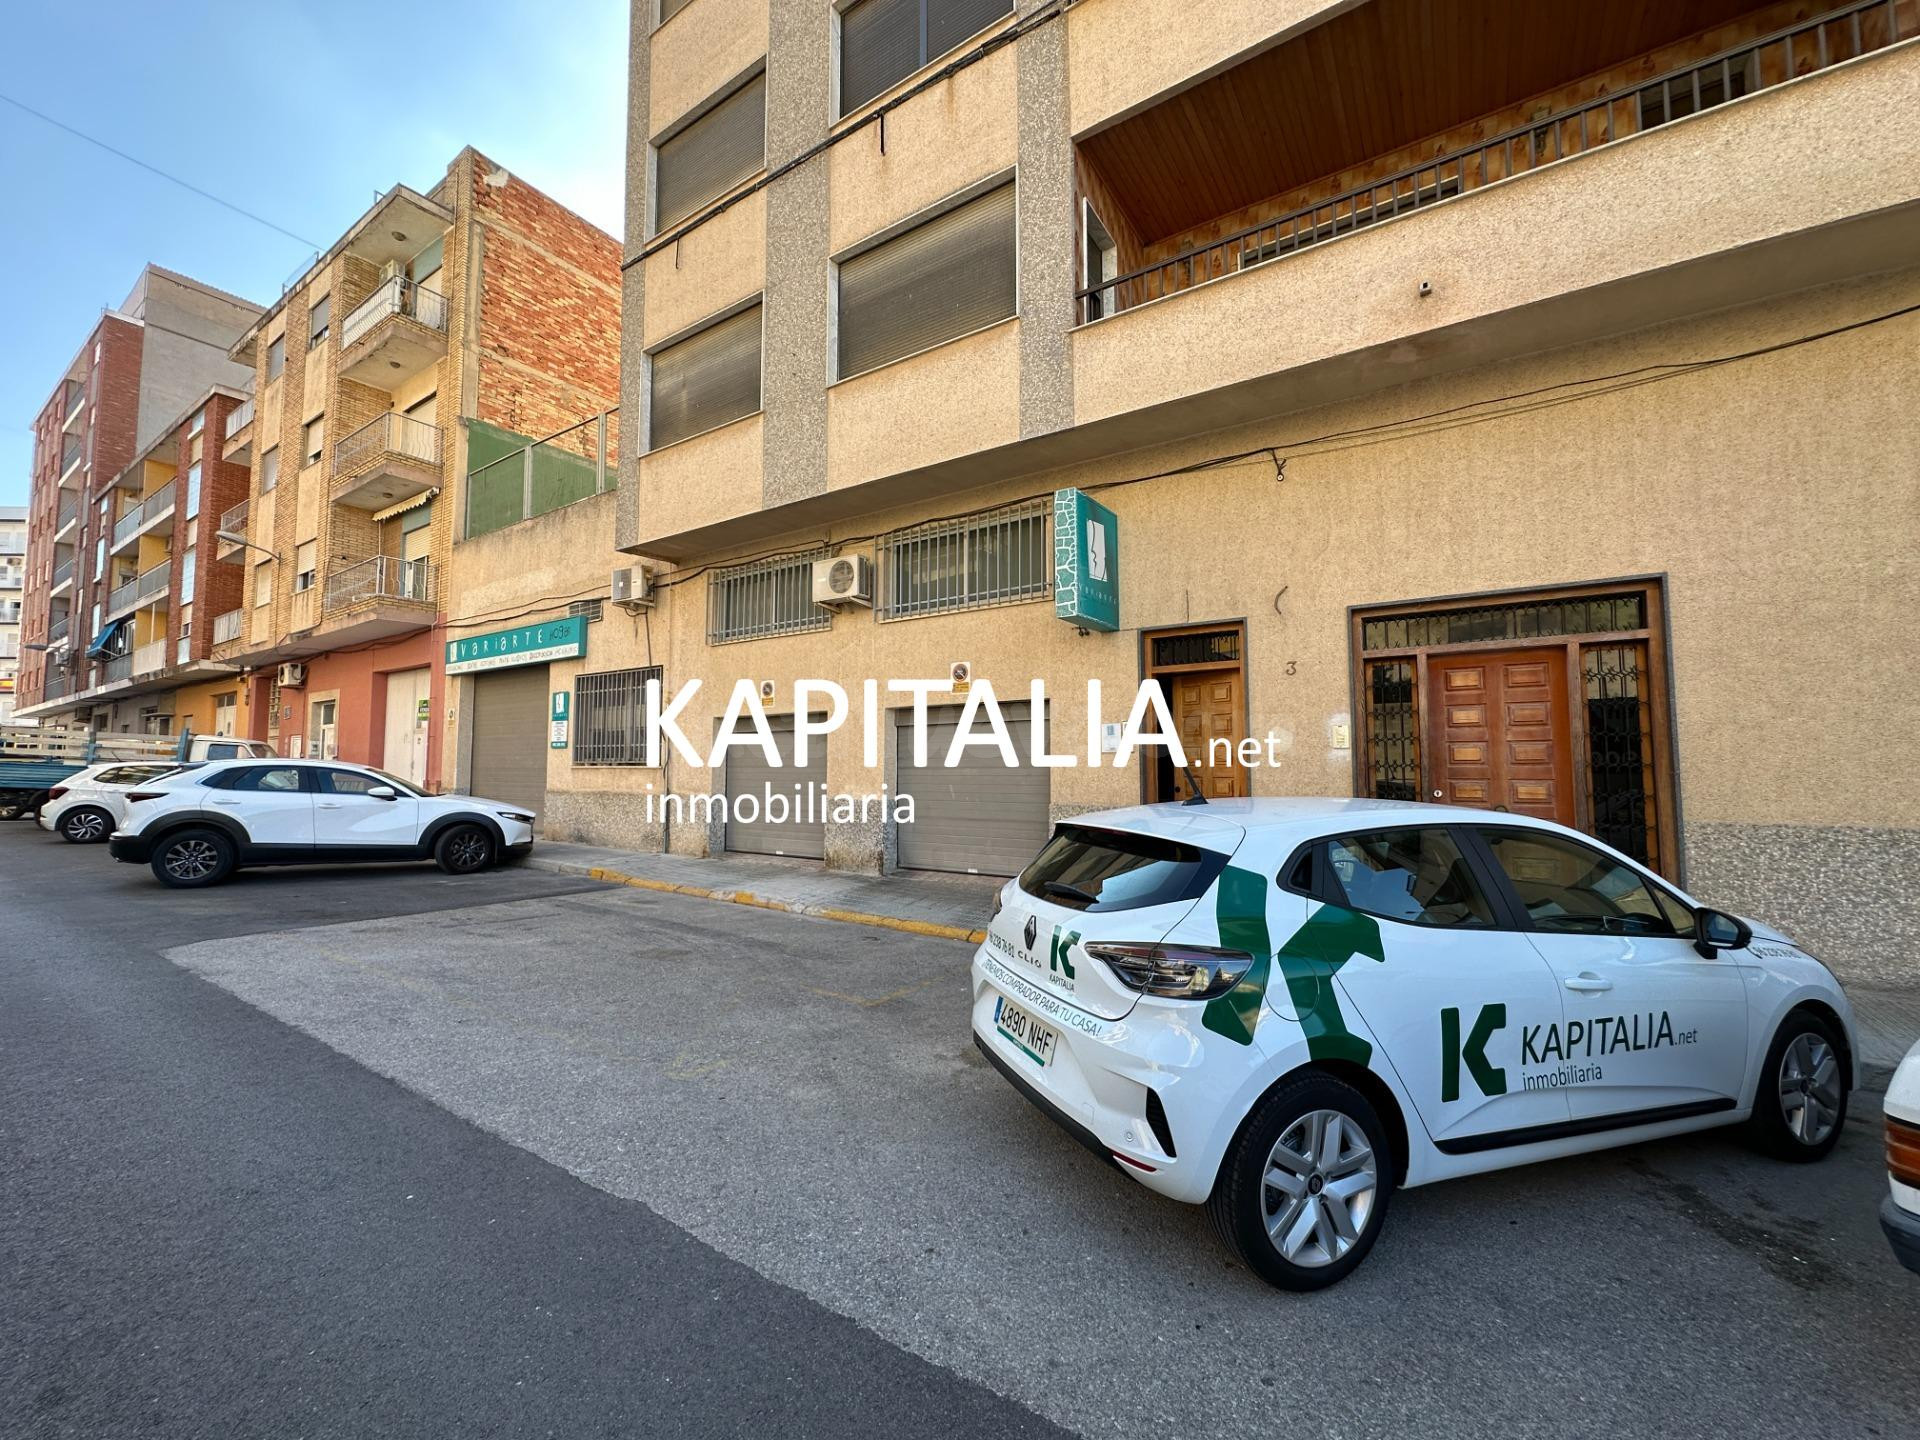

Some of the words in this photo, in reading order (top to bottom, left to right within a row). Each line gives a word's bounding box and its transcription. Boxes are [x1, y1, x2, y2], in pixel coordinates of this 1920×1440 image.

[1286, 660, 1297, 676] 3
[1017, 950, 1042, 968] CLIO
[1049, 973, 1075, 993] KAPITALIA
[1002, 973, 1042, 1005] COMPRADOR
[1039, 995, 1060, 1016] PARA
[1060, 1006, 1073, 1022] TU
[1071, 1014, 1102, 1037] CASA!
[1000, 1003, 1026, 1038] 4890
[1027, 1021, 1053, 1055] NHF
[1521, 1065, 1603, 1092] inmobiliaria
